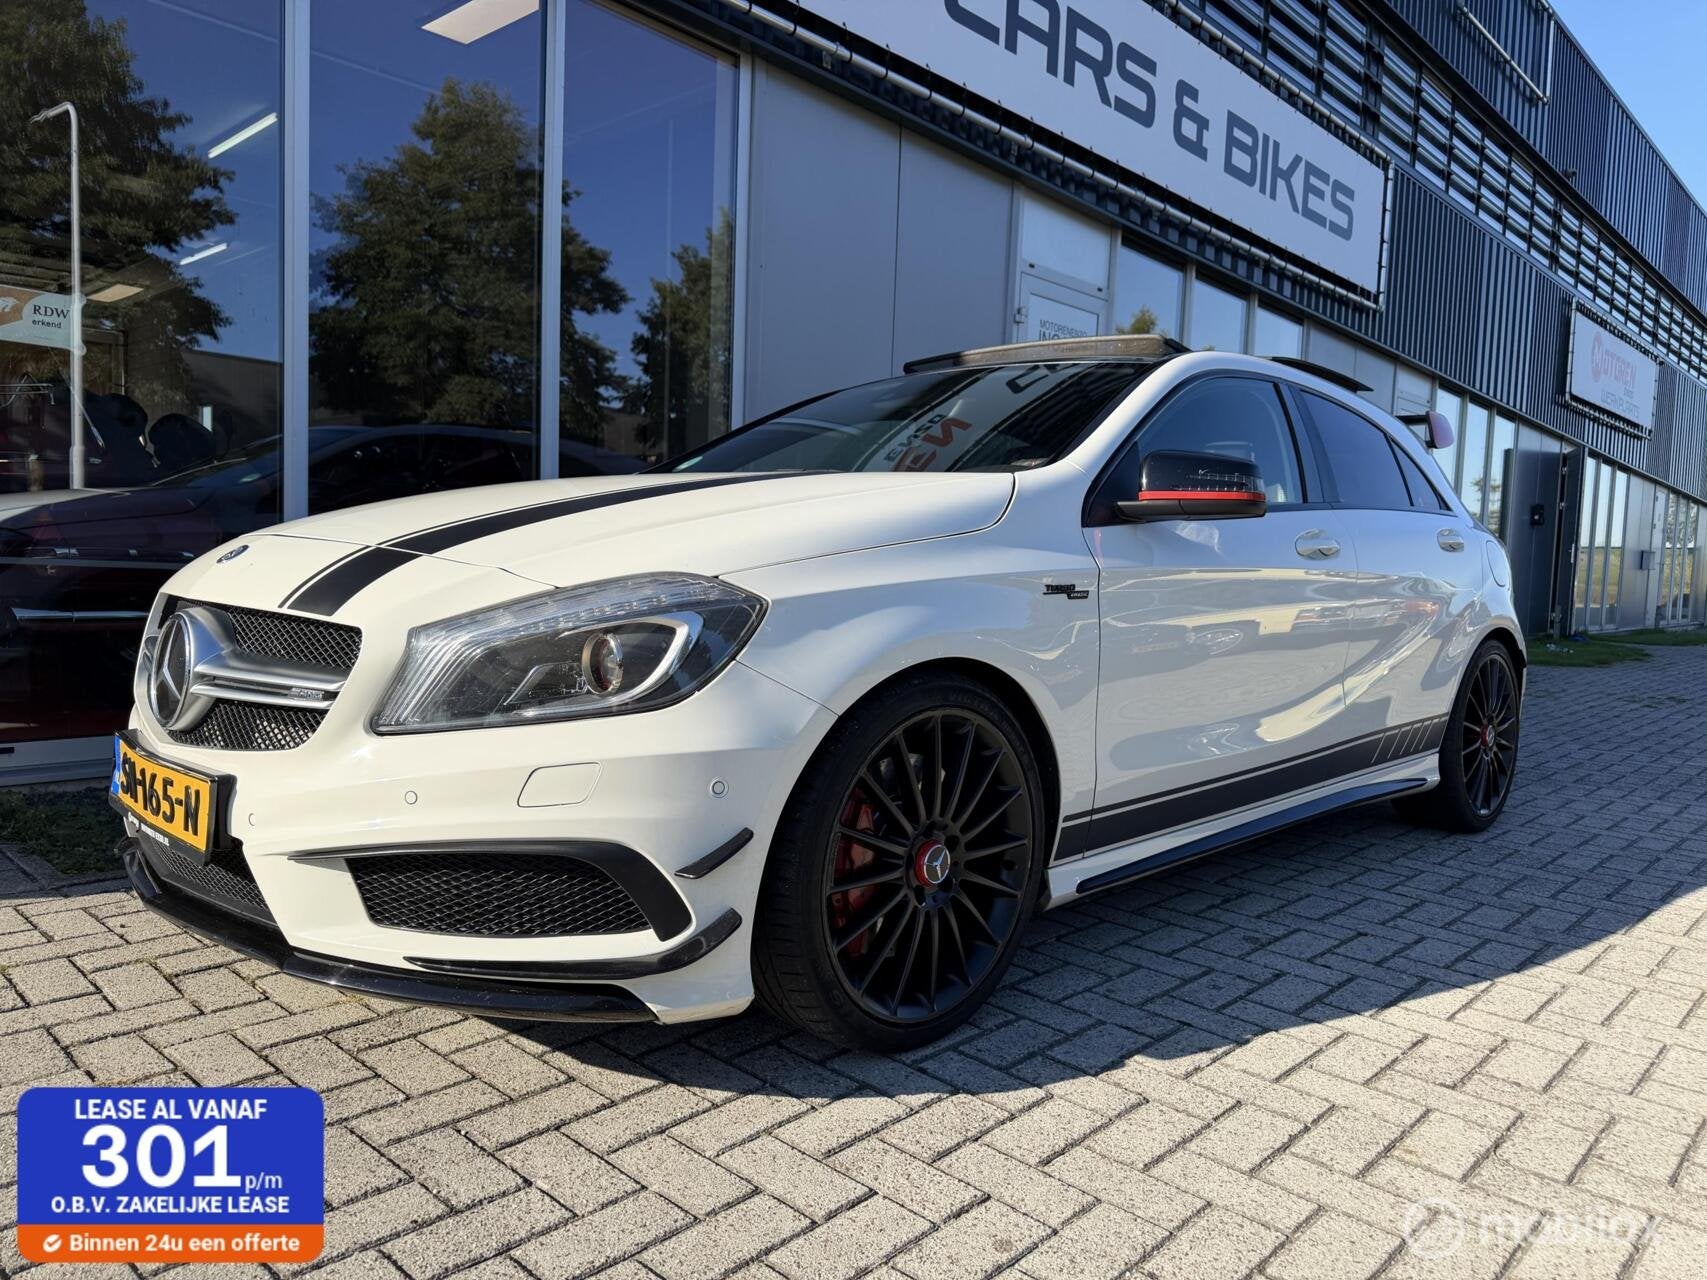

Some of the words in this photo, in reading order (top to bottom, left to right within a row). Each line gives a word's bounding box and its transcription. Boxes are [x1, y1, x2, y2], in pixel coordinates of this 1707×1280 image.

[1173, 79, 1209, 162] &
[1224, 110, 1355, 241] BIKES
[33, 305, 70, 319] RDW
[32, 319, 62, 329] erkend
